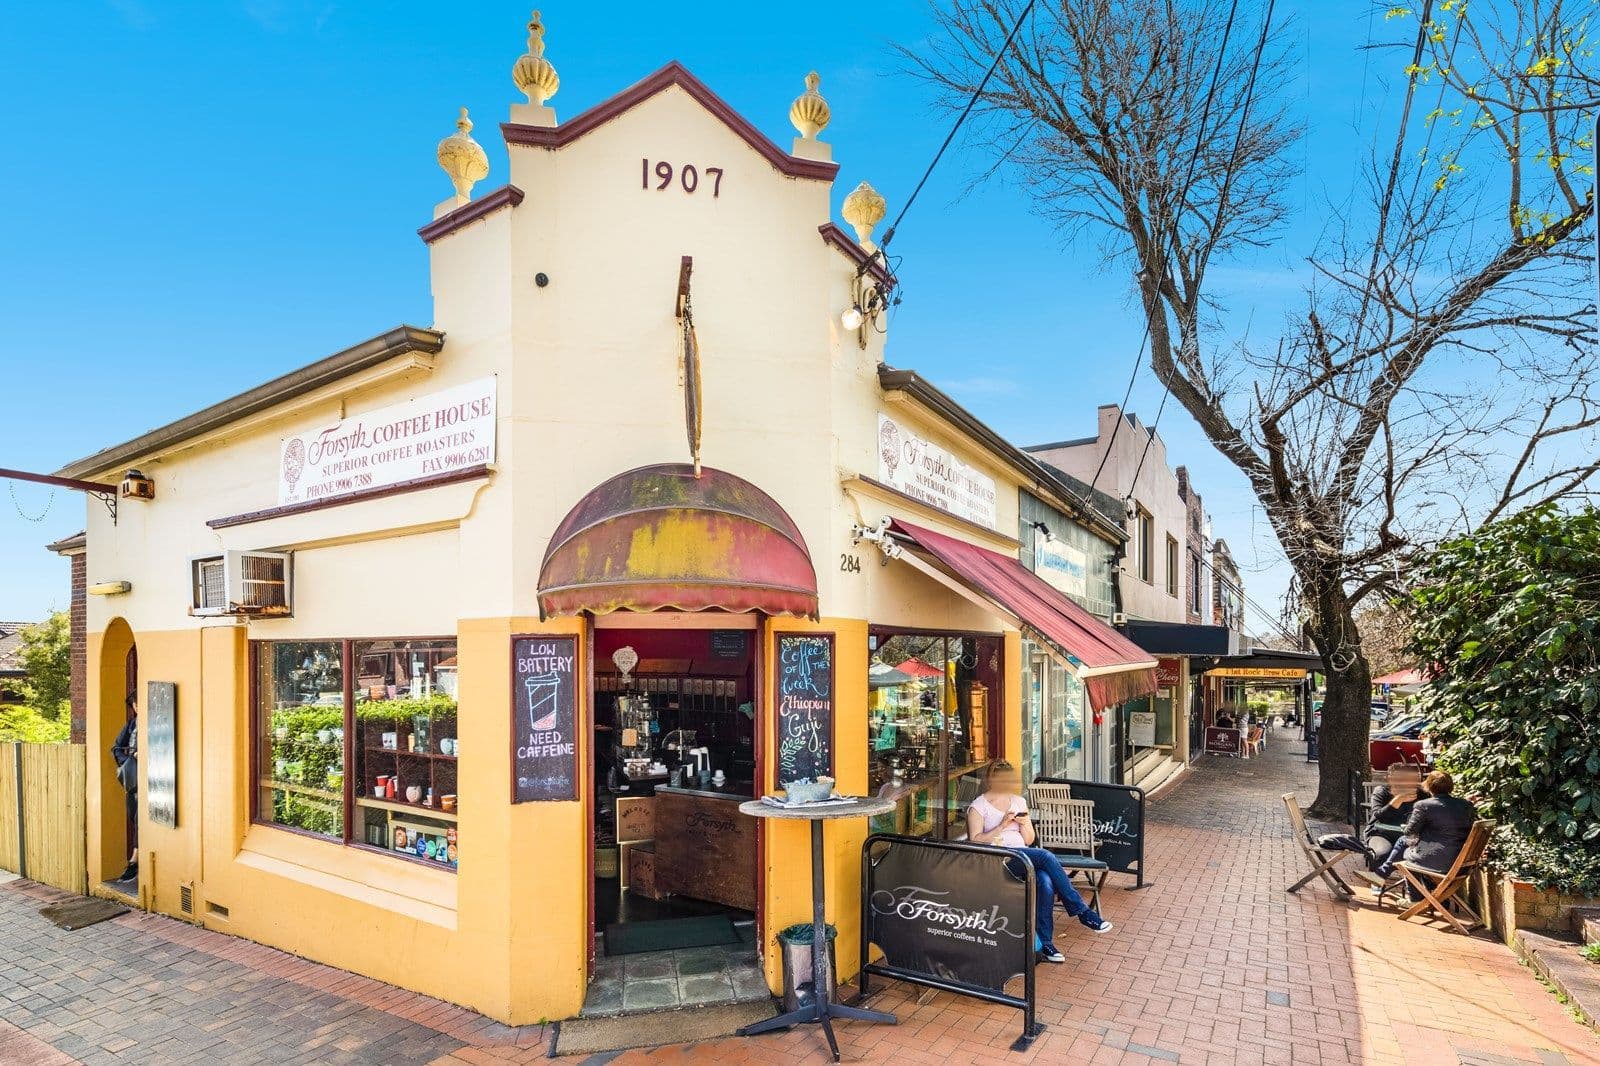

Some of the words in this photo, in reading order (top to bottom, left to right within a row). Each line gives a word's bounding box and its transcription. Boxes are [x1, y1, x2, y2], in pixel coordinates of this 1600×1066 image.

[642, 158, 723, 198] 1907
[308, 423, 374, 466] Forsyth
[373, 413, 431, 444] COFFEE
[435, 396, 491, 429] HOUSE
[322, 454, 368, 478] SUPERIOR
[371, 445, 413, 466] COFFEE
[416, 429, 476, 455] ROASTERS
[422, 457, 442, 474] FAX
[444, 452, 466, 469] 9906
[468, 445, 490, 464] 6281
[307, 479, 335, 498] PHONE
[335, 476, 353, 491] 9906
[354, 473, 373, 487] 7388
[840, 553, 860, 573] 284
[530, 644, 556, 656] LOW
[518, 656, 573, 673] BATTERY
[785, 665, 798, 674] OF
[812, 661, 827, 670] THE
[780, 694, 830, 720] Ethiopian
[530, 731, 561, 745] NEED
[788, 713, 822, 753] Guji
[517, 743, 575, 758] CAFFEINE
[896, 900, 997, 935] Forsyth
[927, 926, 953, 938] superior
[953, 932, 976, 942] coffees
[976, 935, 982, 943] &
[983, 938, 998, 947] teas
